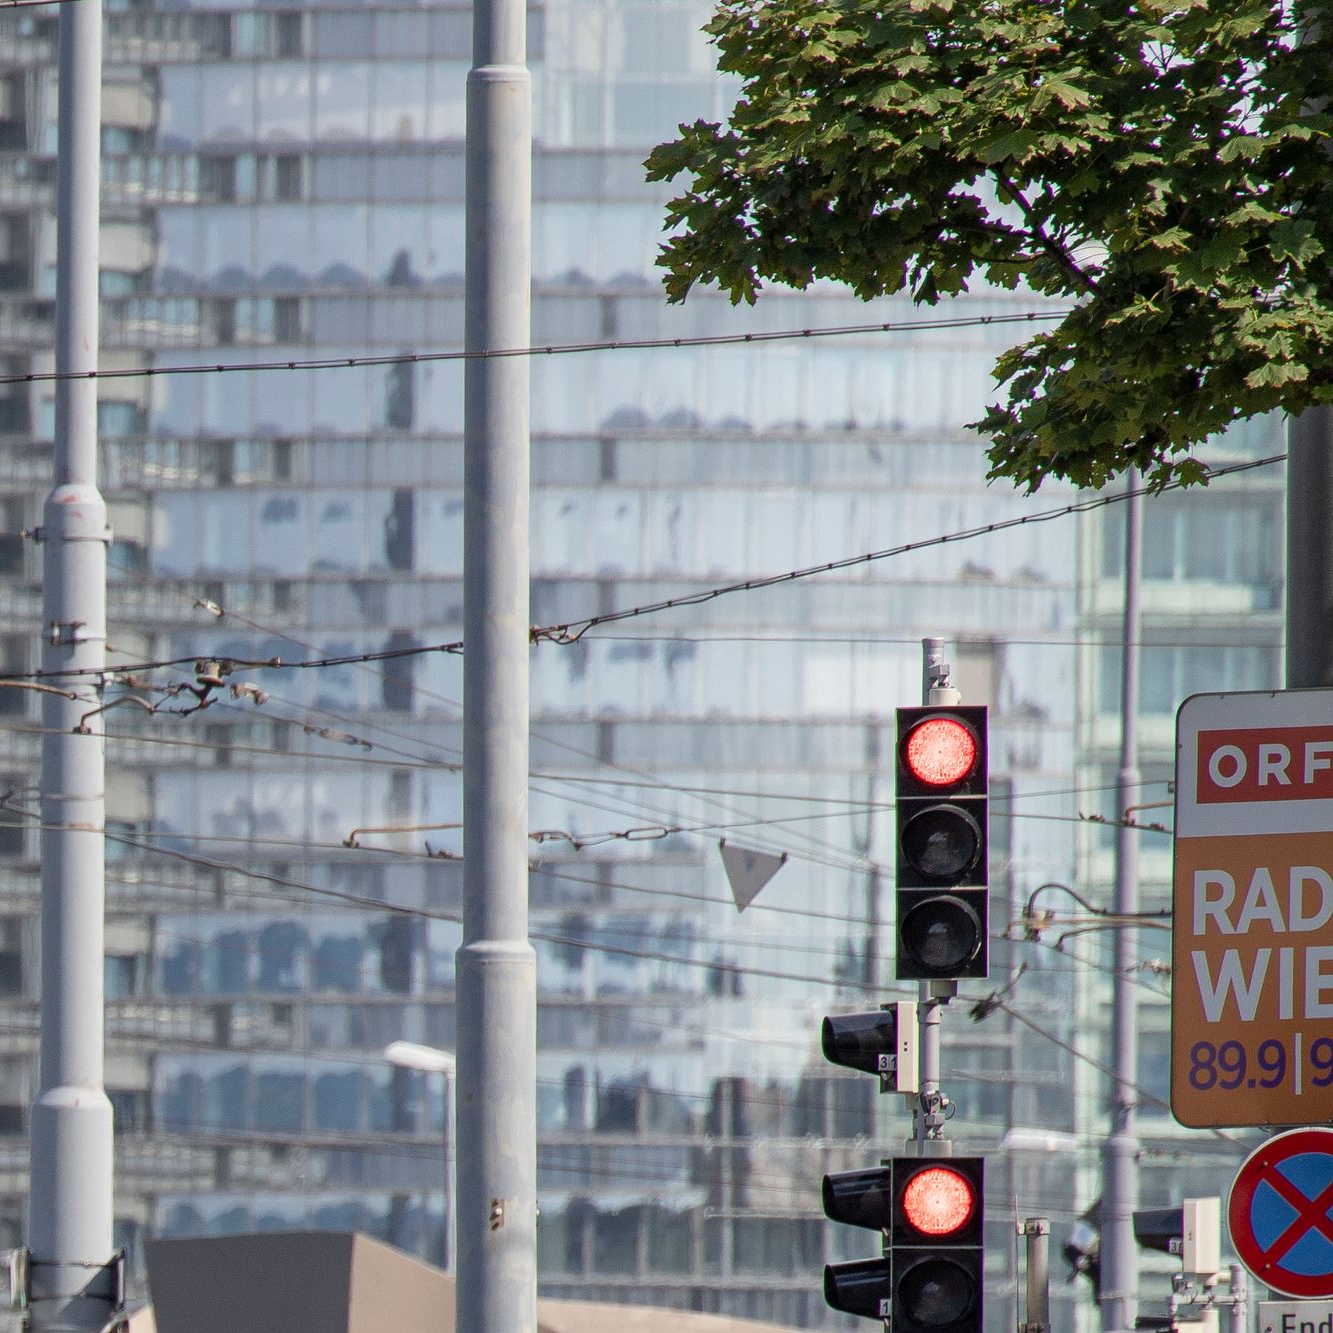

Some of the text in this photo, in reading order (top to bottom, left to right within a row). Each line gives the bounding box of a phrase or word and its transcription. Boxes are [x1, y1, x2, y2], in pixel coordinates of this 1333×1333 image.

[1208, 742, 1333, 788] ORF
[1193, 867, 1333, 936] RAD
[1190, 946, 1333, 1024] WIE
[1188, 1039, 1286, 1090] 89.9
